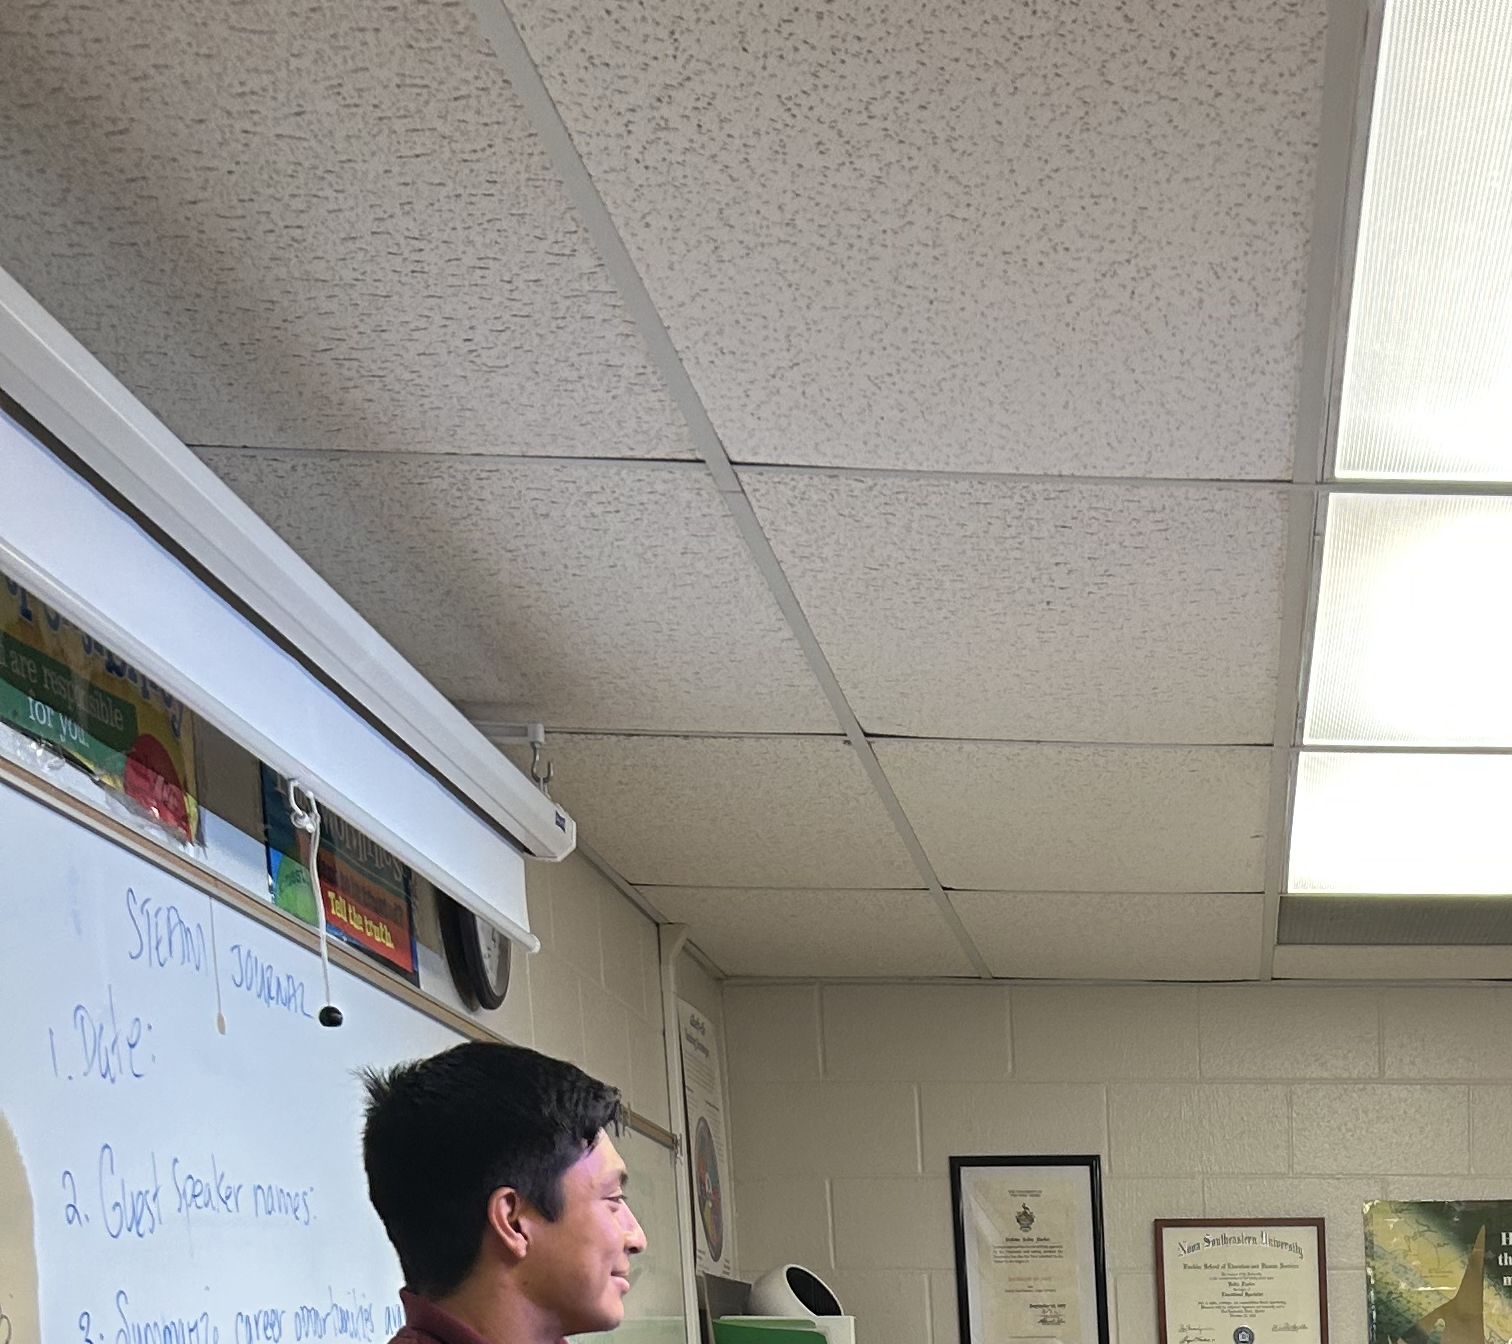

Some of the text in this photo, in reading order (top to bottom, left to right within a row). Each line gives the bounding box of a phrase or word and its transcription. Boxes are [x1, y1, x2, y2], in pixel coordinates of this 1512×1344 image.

[28, 696, 54, 727] for
[43, 664, 124, 731] responsible
[328, 891, 395, 949] Tell the truth.
[230, 944, 314, 1020] JOURNAL
[49, 984, 156, 1084] 1. Date:
[62, 1143, 317, 1239] 2. Guest Speaker names:
[1203, 1232, 1258, 1248] Southeastern
[1260, 1230, 1303, 1259] University
[385, 1303, 405, 1336] an
